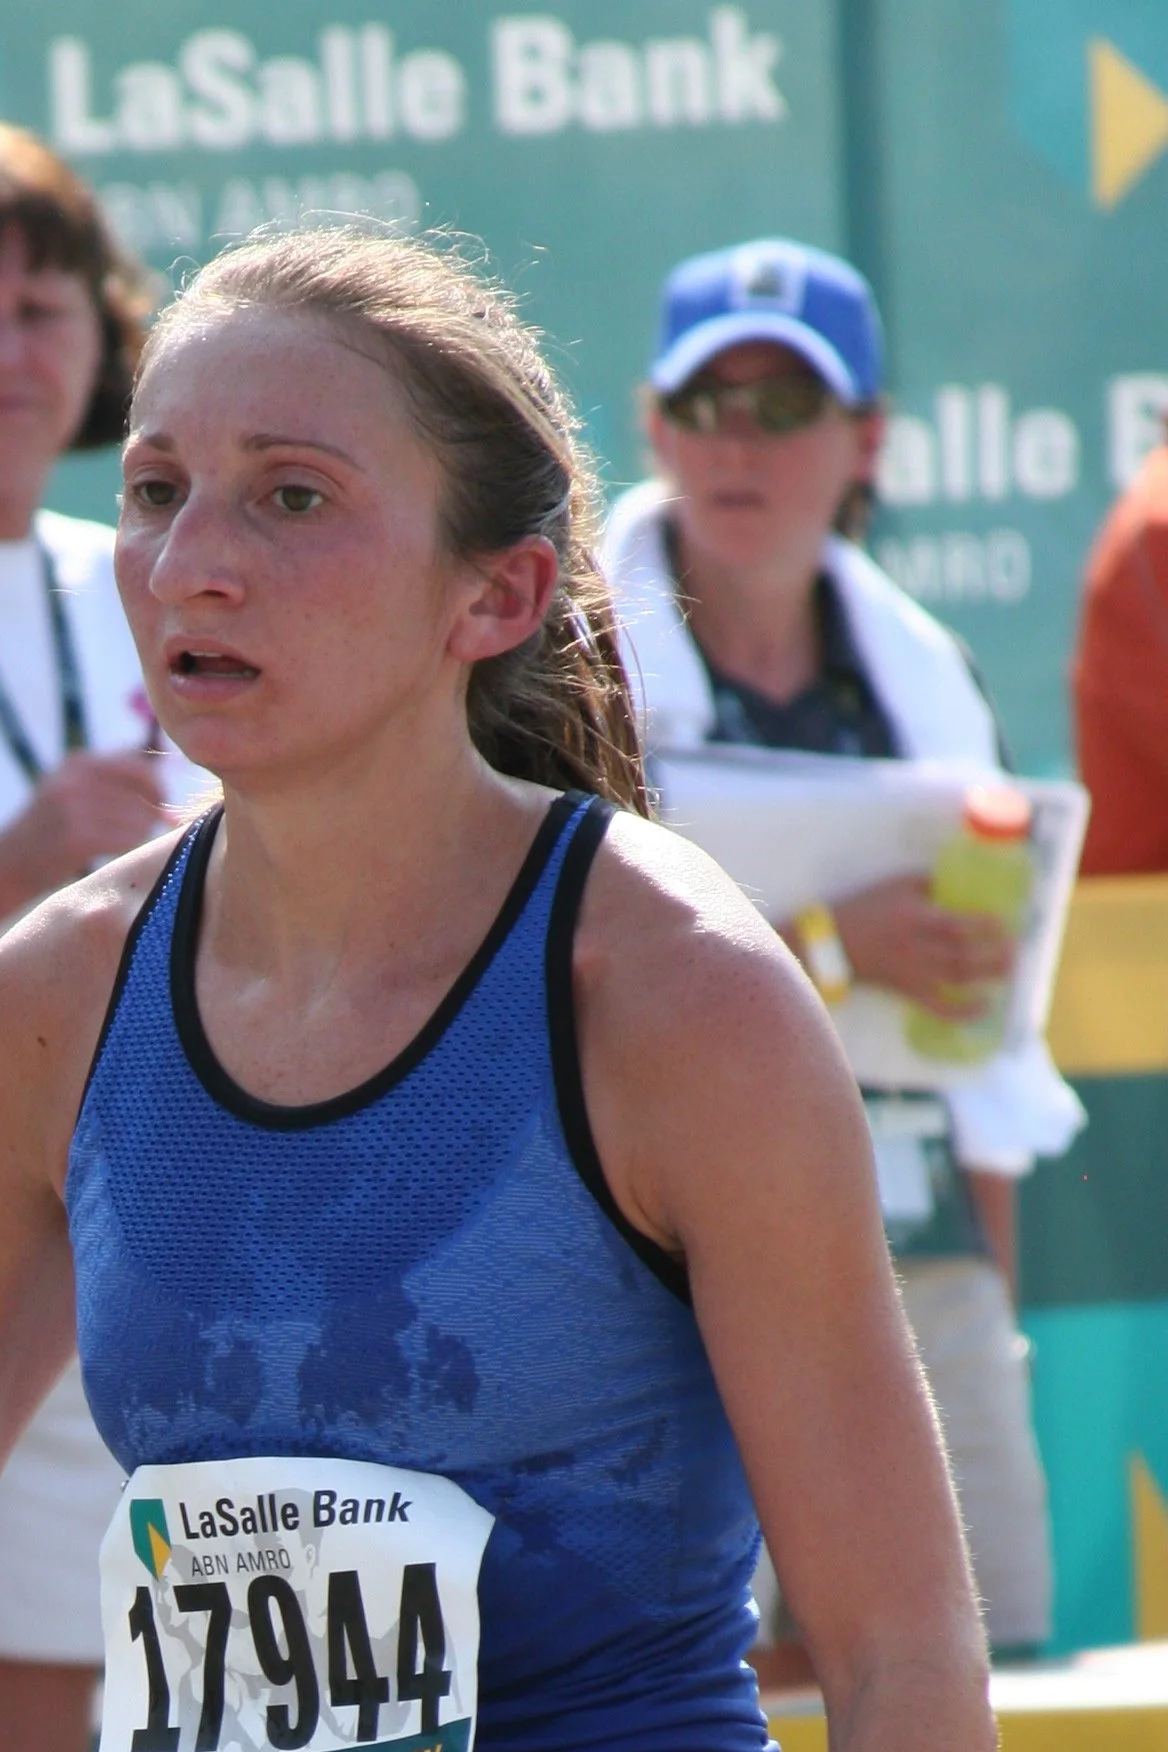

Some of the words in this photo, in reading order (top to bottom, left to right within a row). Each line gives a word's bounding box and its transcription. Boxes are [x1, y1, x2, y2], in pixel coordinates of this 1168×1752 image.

[49, 23, 466, 154] LaSalle
[490, 6, 786, 135] Bank
[179, 1493, 300, 1540] LaSalle
[313, 1489, 413, 1528] Bank
[191, 1554, 229, 1577] ABN
[236, 1548, 292, 1573] AMRO
